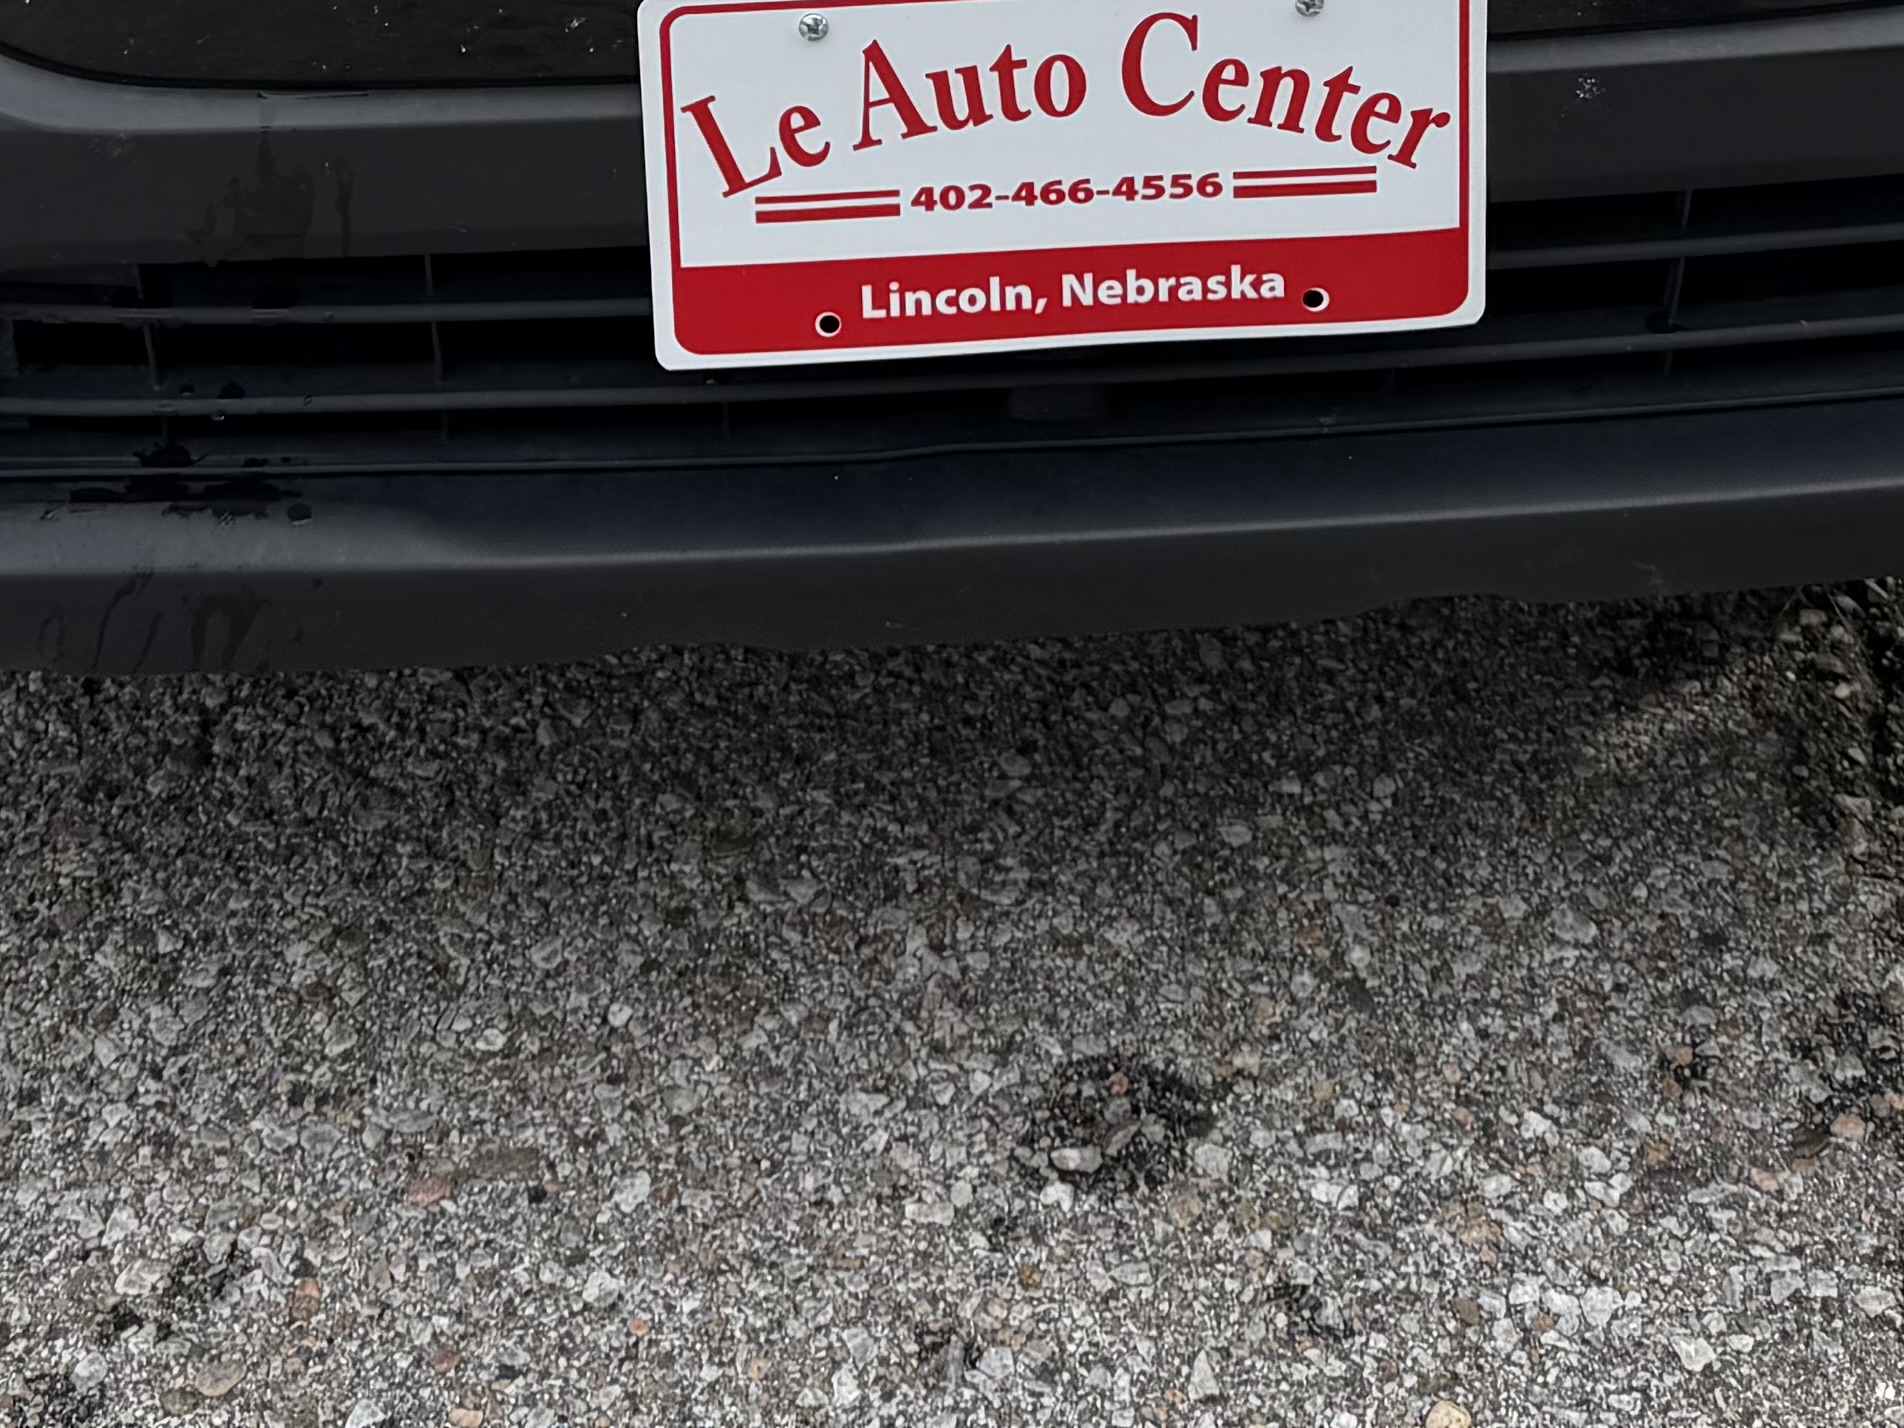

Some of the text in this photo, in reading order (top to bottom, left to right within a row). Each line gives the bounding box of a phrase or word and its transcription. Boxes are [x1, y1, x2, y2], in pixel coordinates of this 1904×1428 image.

[681, 12, 1452, 198] Le Auto Center
[911, 172, 1224, 212] 402-466-4556
[861, 265, 1286, 319] Lincoln, Nebraska
